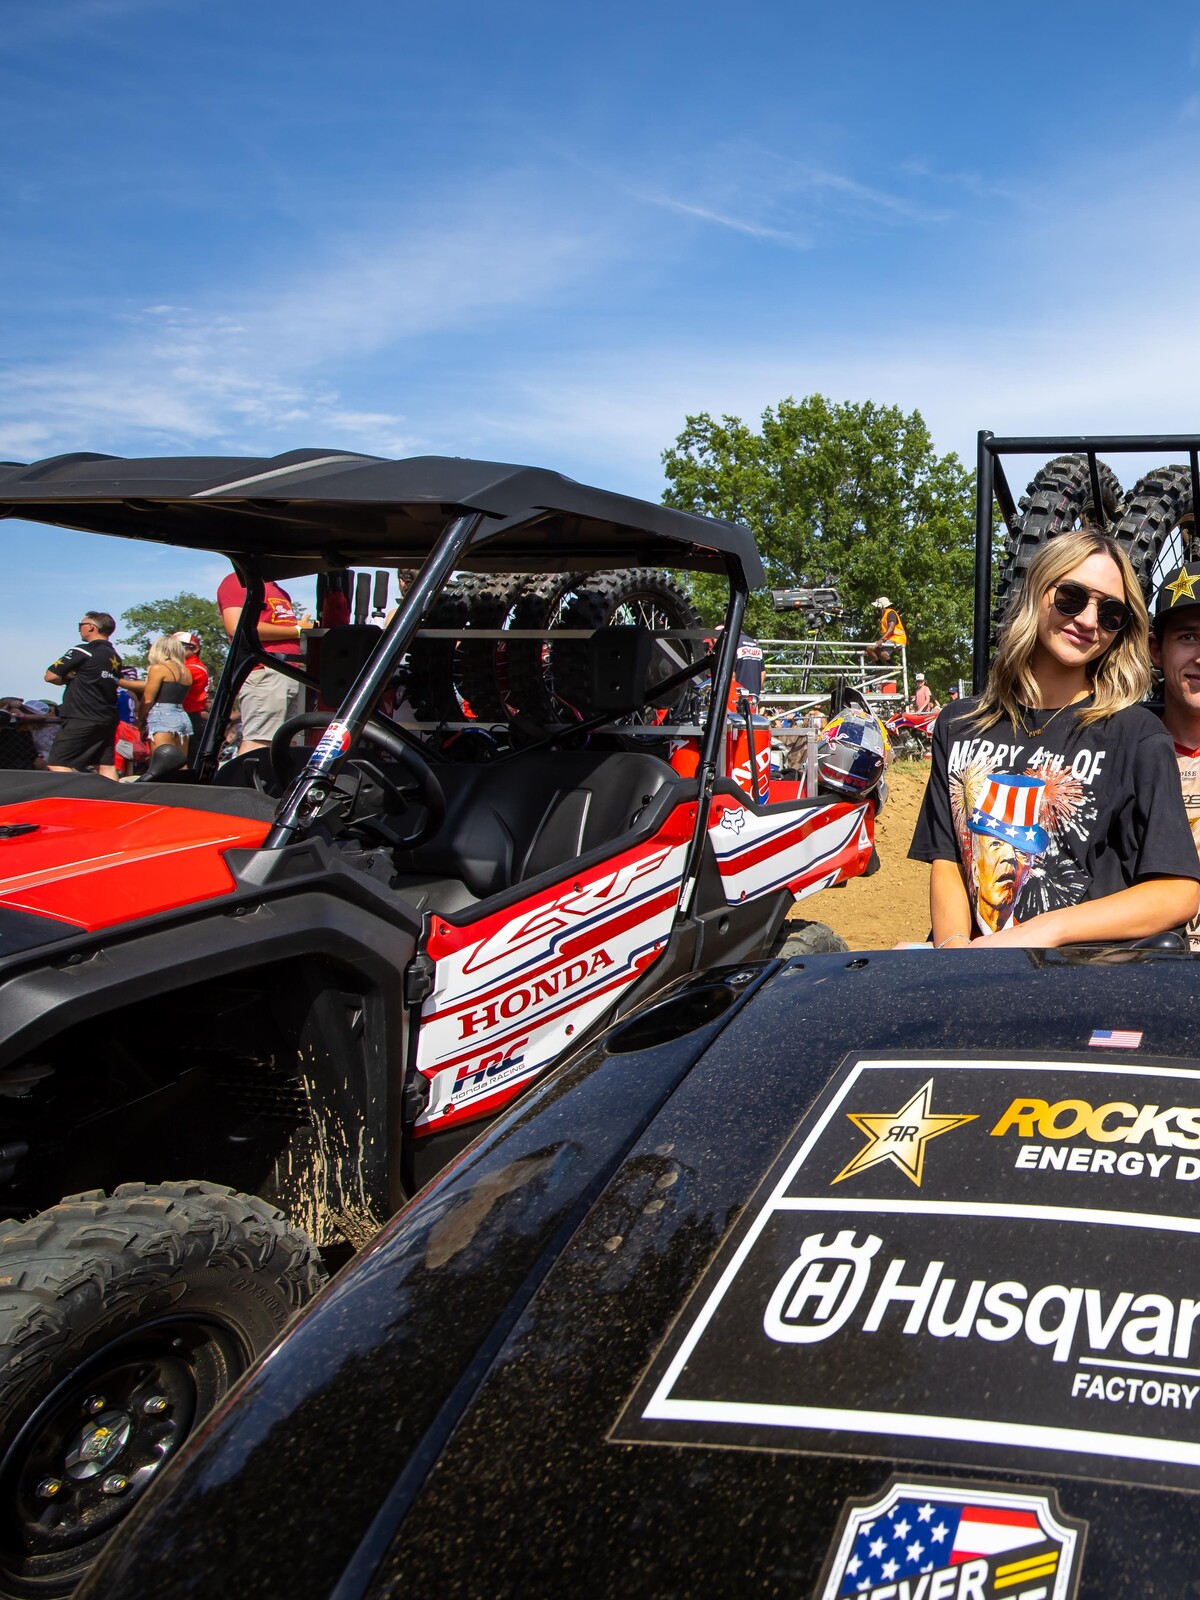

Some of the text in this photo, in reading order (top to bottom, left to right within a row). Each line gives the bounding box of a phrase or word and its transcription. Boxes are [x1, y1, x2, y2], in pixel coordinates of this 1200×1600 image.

[948, 738, 1024, 774] MERRY
[1071, 749, 1106, 785] OF
[457, 949, 614, 1040] HONDA
[450, 1063, 526, 1101] Honda RACING
[452, 1036, 529, 1094] HRC
[1015, 1145, 1173, 1178] ENERGY
[1071, 1373, 1200, 1410] FACTORY
[838, 1558, 990, 1600] EVER
